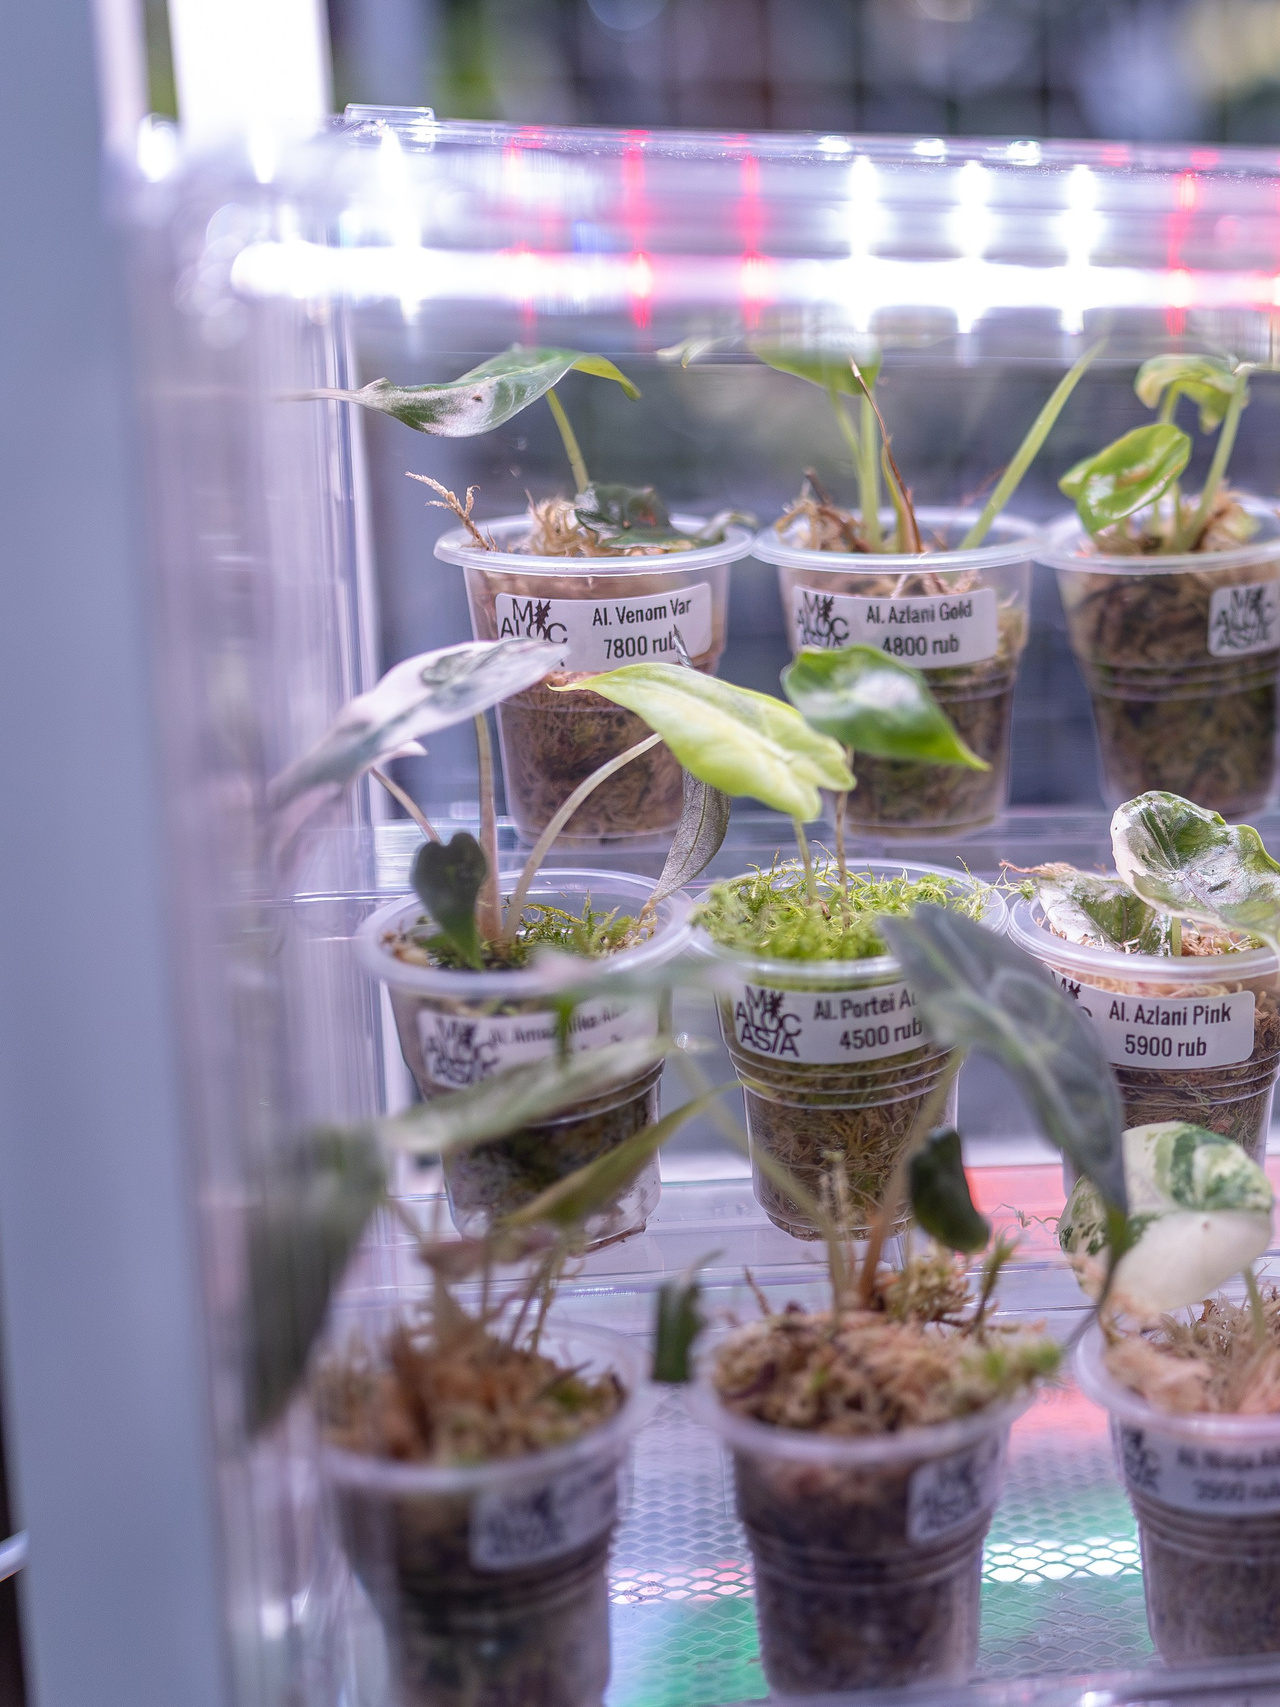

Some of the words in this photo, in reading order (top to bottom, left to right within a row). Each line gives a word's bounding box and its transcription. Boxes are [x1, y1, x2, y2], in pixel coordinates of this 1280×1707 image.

[592, 607, 612, 627] Al.
[615, 604, 667, 627] Venom
[670, 598, 692, 617] Var
[866, 605, 884, 625] Al.
[888, 605, 936, 624] Azlani
[939, 599, 973, 621] Gold
[604, 636, 647, 660] 7800
[882, 636, 927, 657] 4800
[932, 634, 960, 655] rub
[1109, 1000, 1129, 1022] Al.
[1134, 1004, 1187, 1026] Azlani
[1193, 1002, 1232, 1025] Pink
[740, 1023, 800, 1057] ASIA
[839, 1025, 889, 1050] 4500
[894, 1017, 923, 1042] rub
[1124, 1034, 1173, 1057] 5900
[1178, 1036, 1207, 1057] rub
